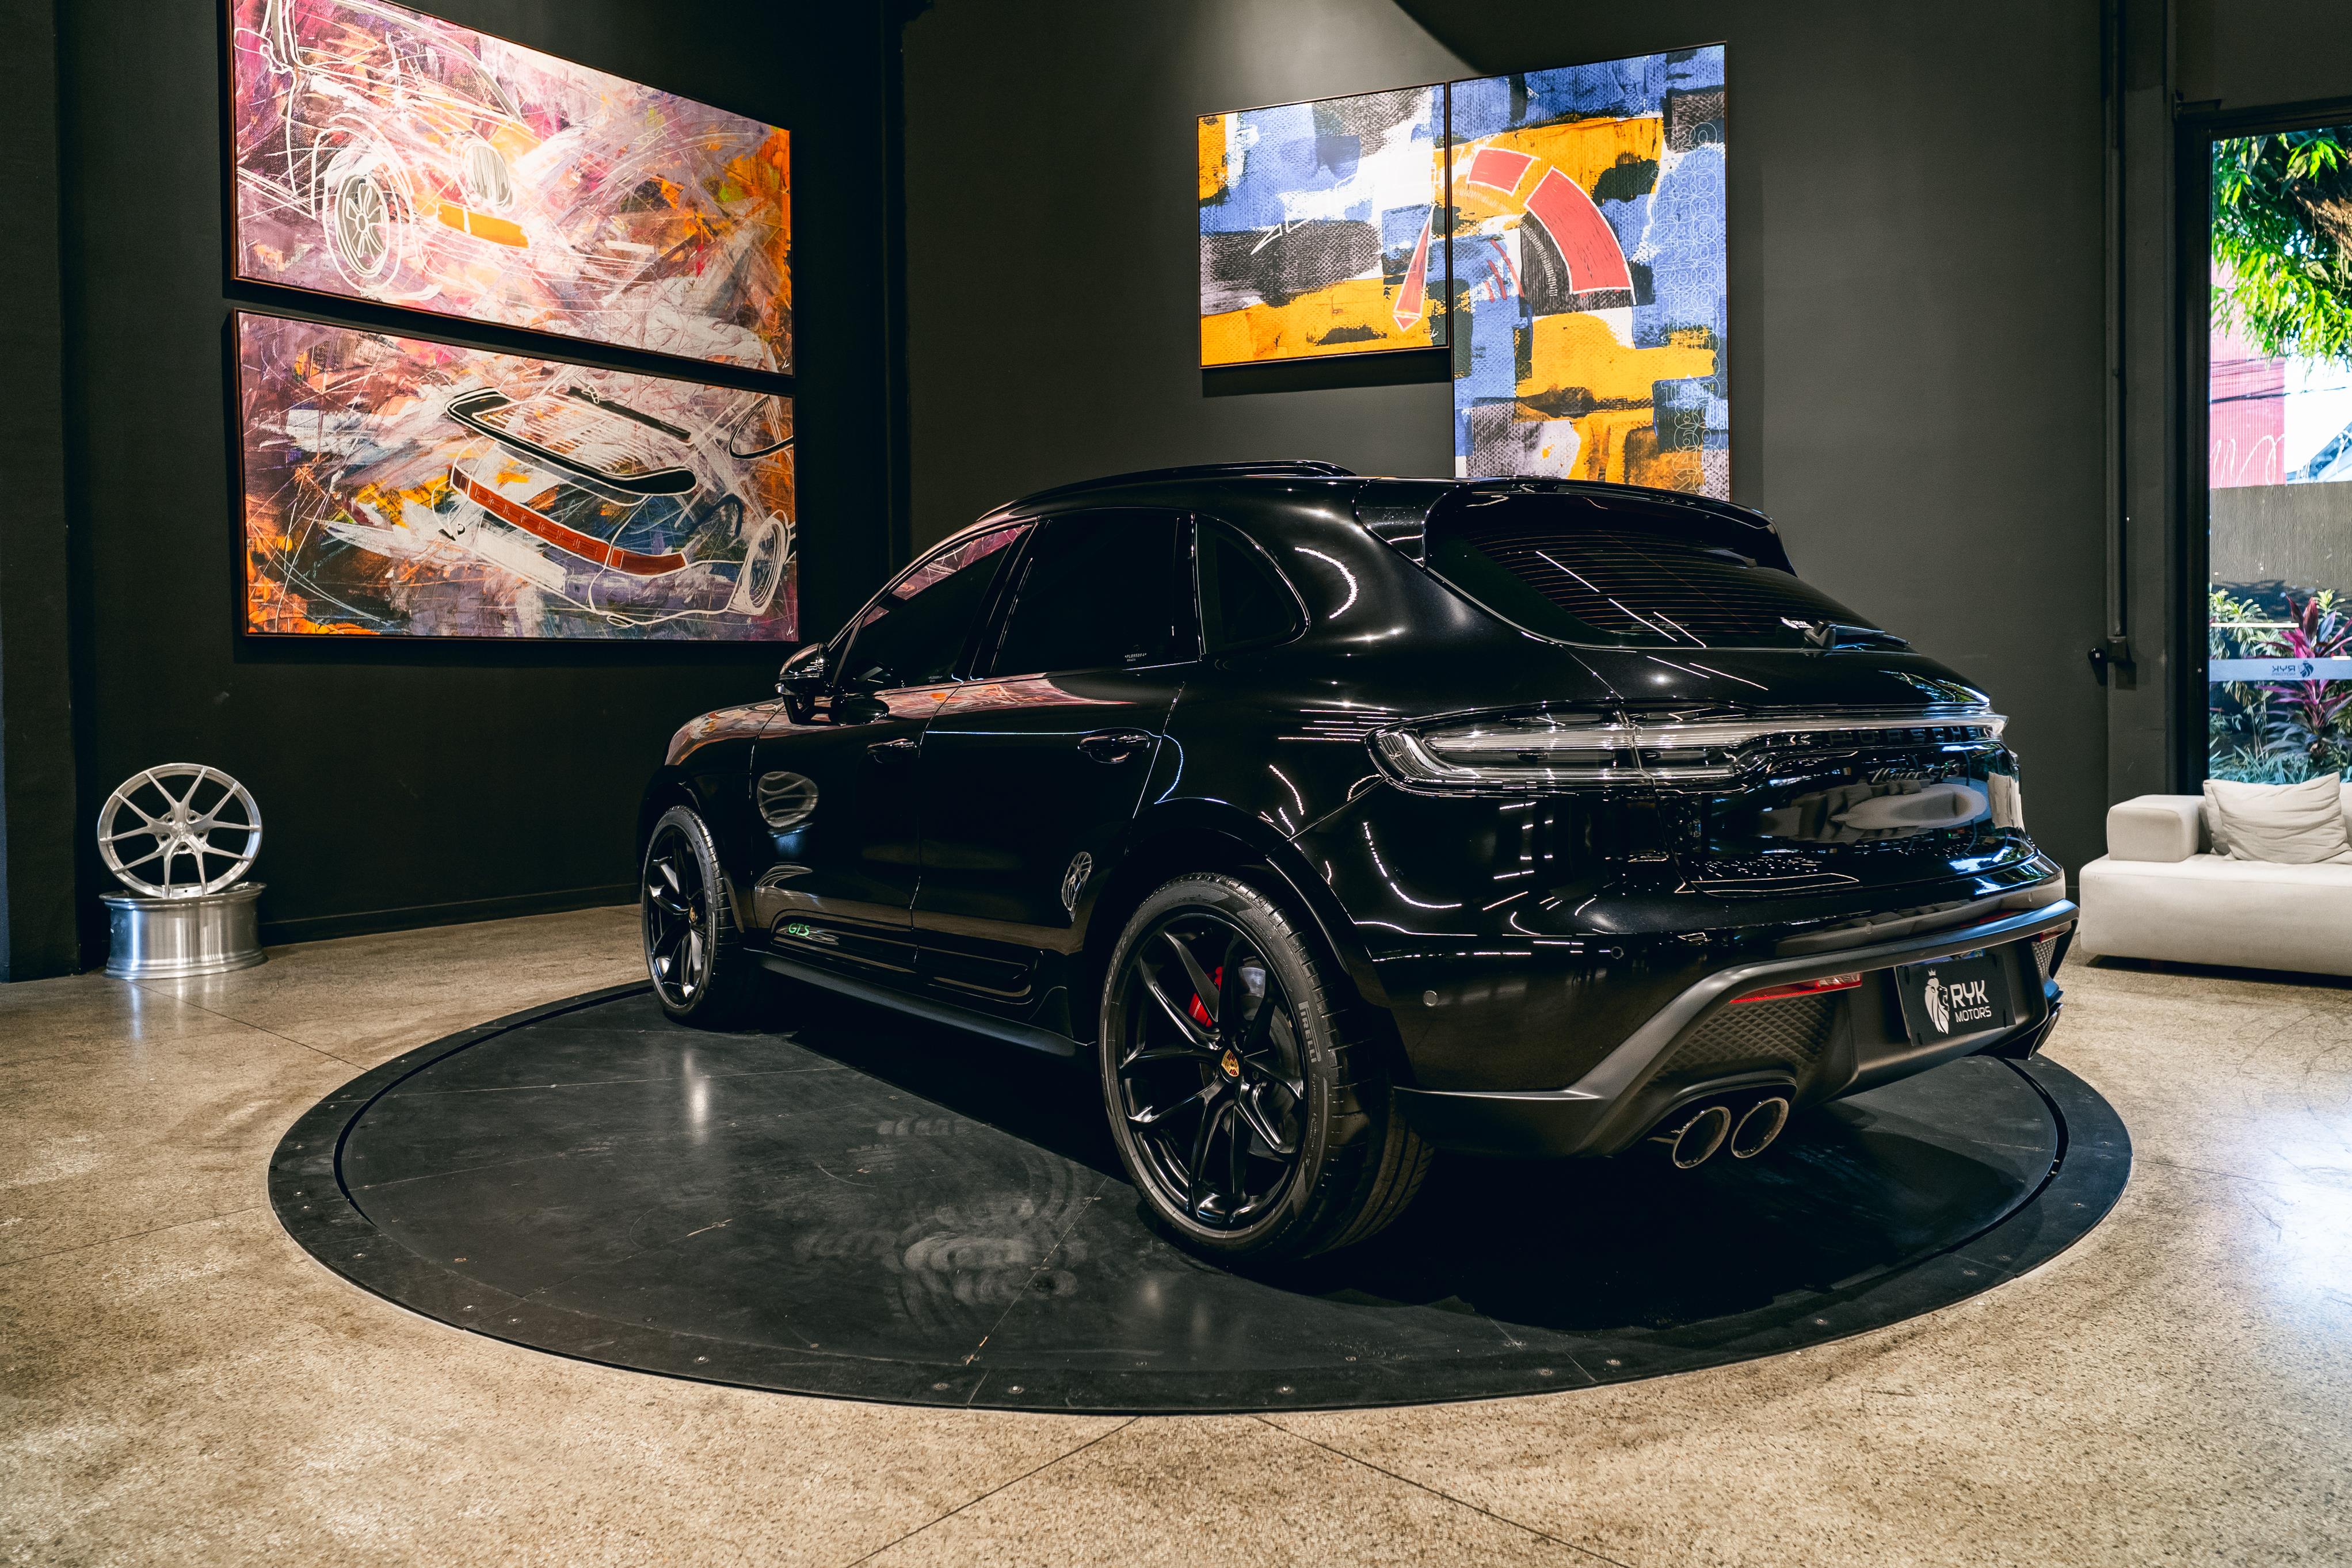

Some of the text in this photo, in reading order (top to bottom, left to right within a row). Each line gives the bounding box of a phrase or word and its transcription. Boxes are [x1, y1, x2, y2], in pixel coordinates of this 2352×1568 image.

[1674, 421, 1721, 452] 60
[788, 923, 810, 936] GTS
[1950, 980, 1989, 1008] RYK
[1955, 1006, 1991, 1023] MOTORS
[1298, 1001, 1322, 1063] PIRELLI
